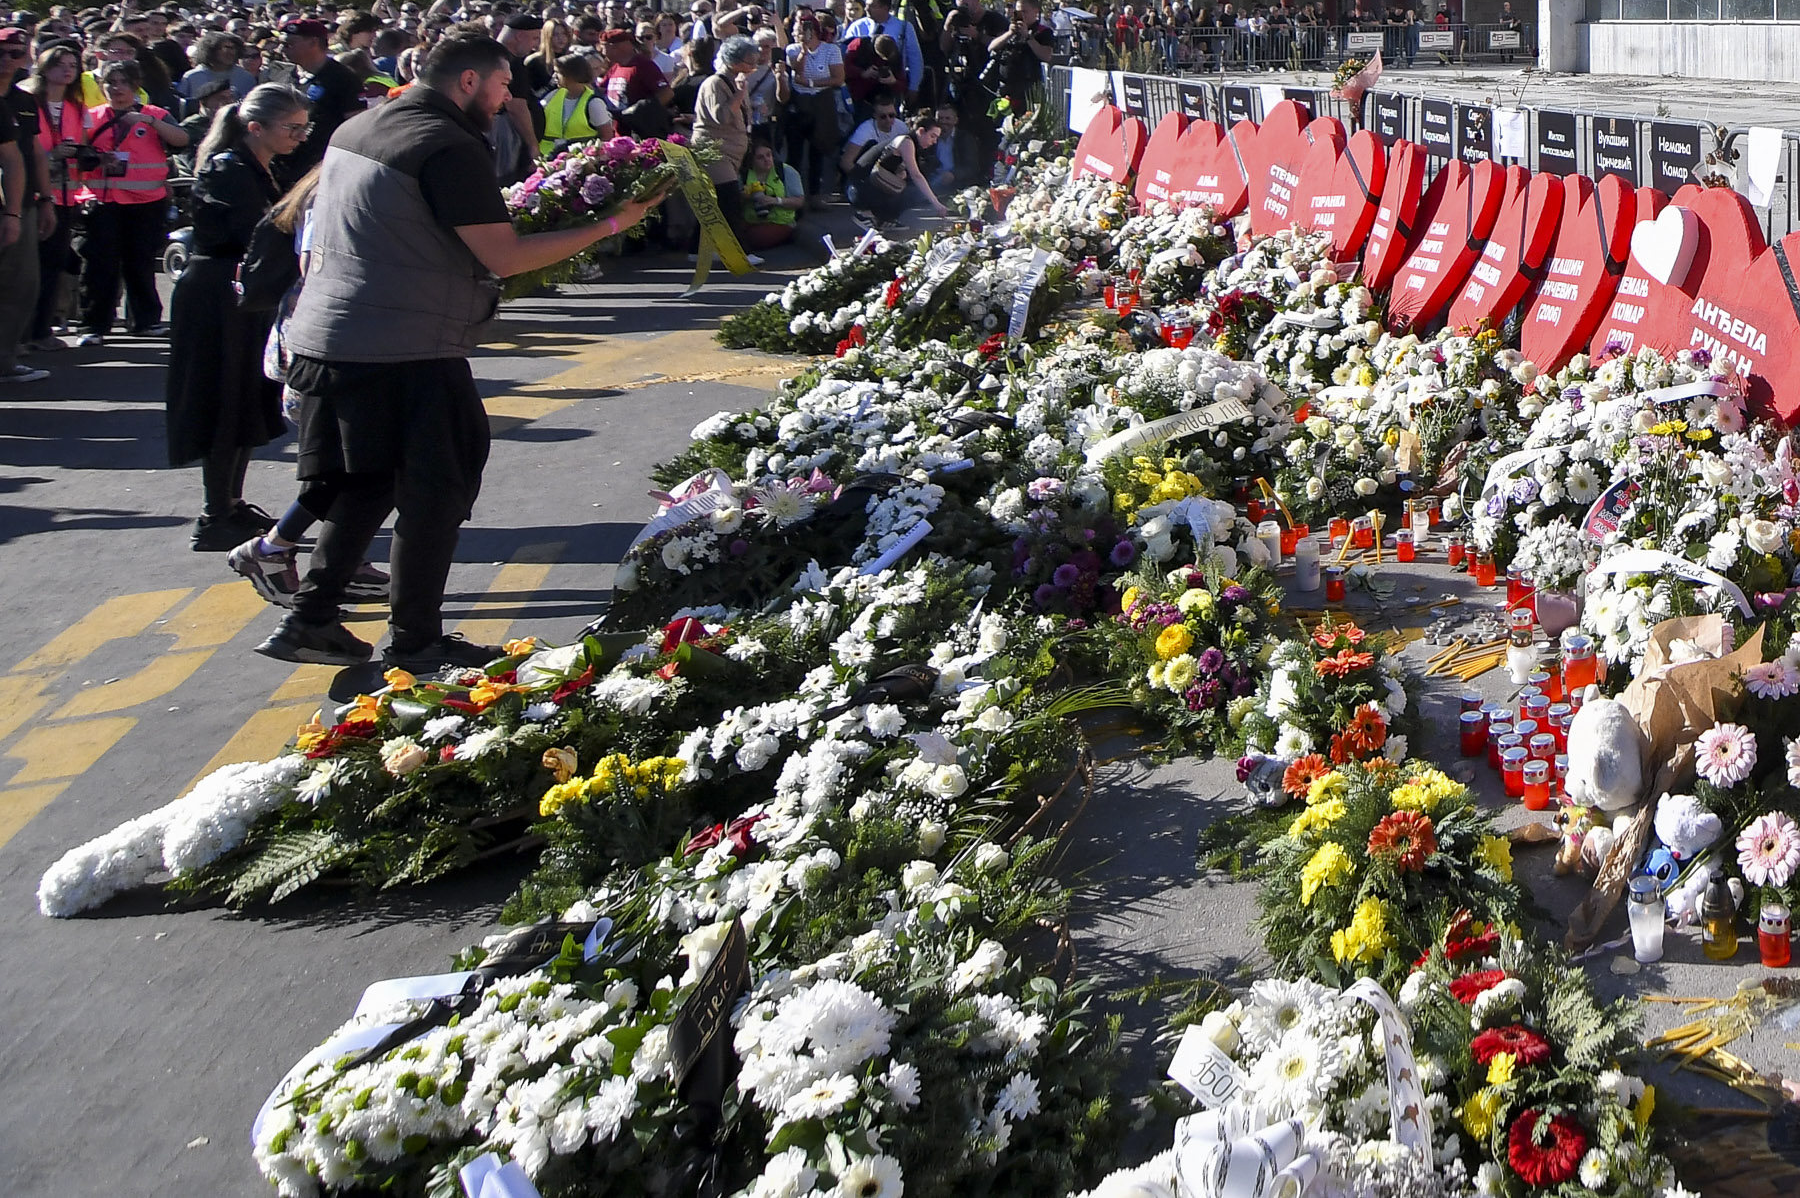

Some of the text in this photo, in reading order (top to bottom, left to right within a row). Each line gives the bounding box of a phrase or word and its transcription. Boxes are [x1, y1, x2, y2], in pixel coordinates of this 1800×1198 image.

[1597, 130, 1629, 149] Вукашин
[1658, 136, 1692, 156] Немања
[1596, 152, 1633, 172] Црнчевић
[1662, 160, 1689, 184] Комар
[1269, 181, 1292, 203] ХРКА
[1310, 194, 1346, 209] ГОРАНКА
[1263, 196, 1288, 220] (1997)
[1313, 212, 1336, 228] РАЦА
[1536, 303, 1562, 328] (2006)
[1611, 301, 1645, 324] КОМАР
[1691, 298, 1768, 356] АНЂЕЛА
[1689, 327, 1753, 379] РУМАН
